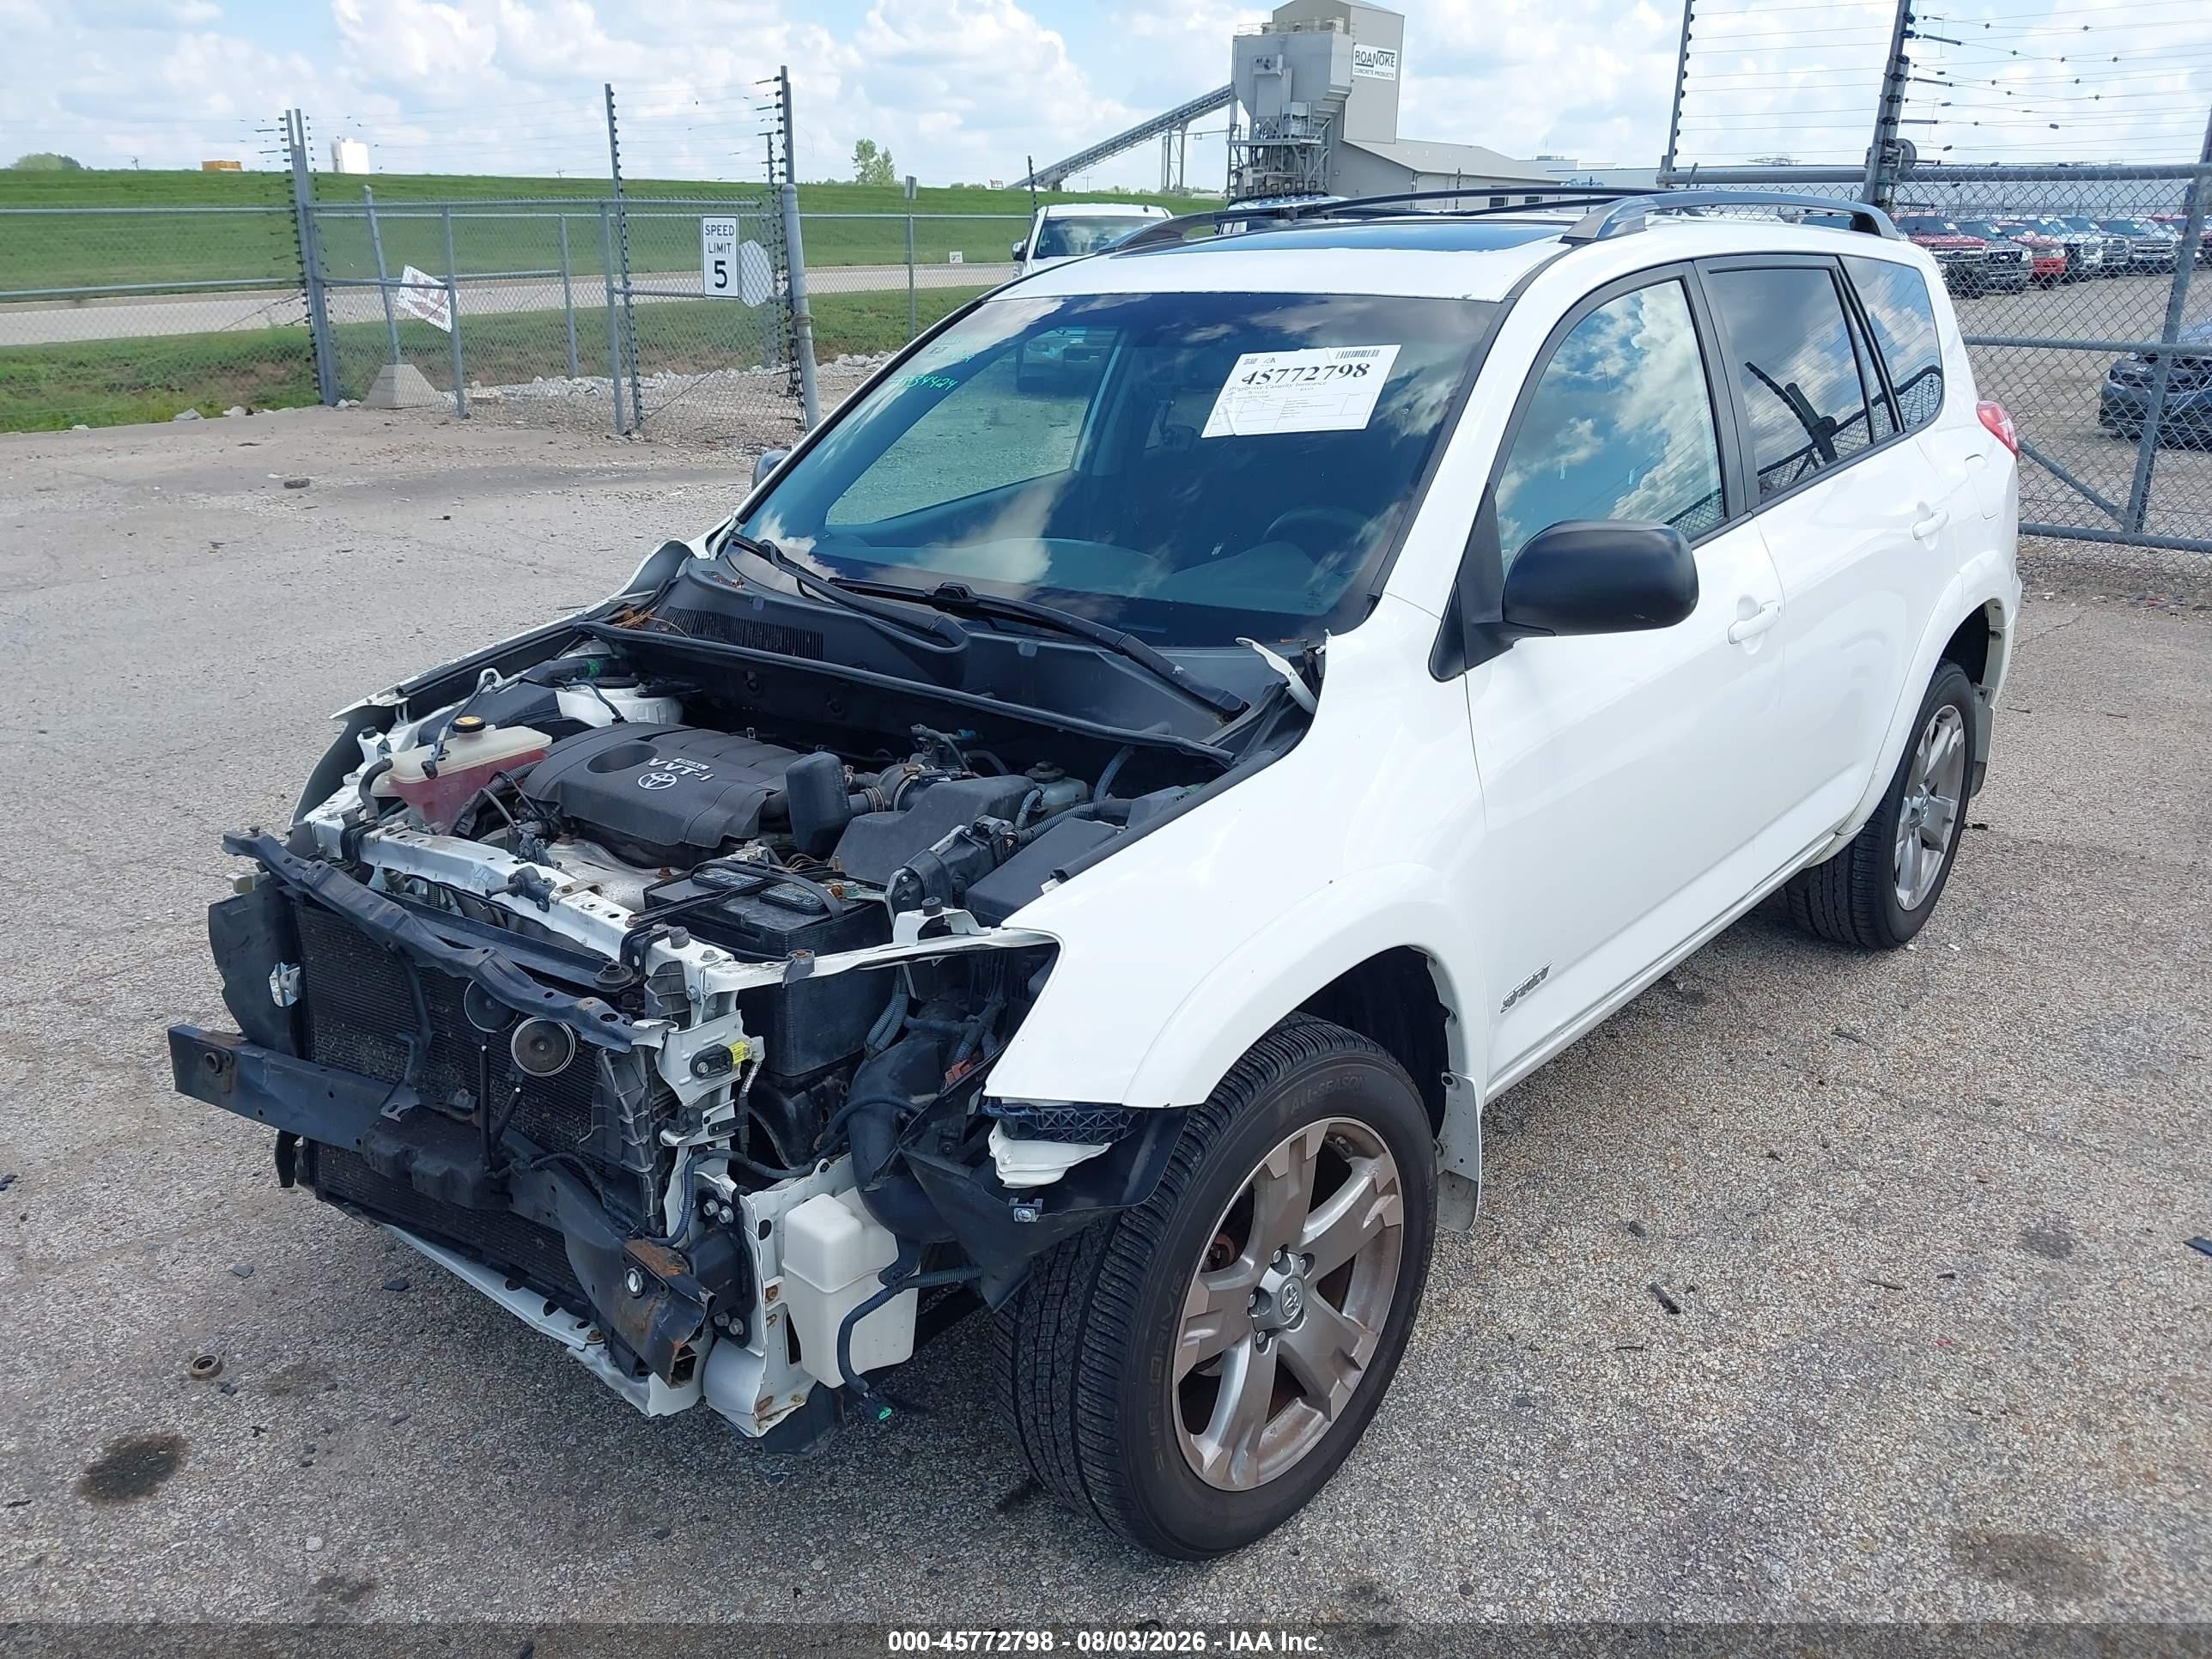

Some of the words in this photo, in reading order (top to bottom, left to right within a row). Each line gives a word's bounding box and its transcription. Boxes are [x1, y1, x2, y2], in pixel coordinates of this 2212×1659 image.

[1355, 50, 1395, 68] ROANOKE
[705, 225, 735, 236] SPEED
[708, 242, 732, 254] LIMIT
[714, 260, 727, 289] 5
[1241, 362, 1370, 386] 45772798
[647, 758, 715, 781] VVT-i
